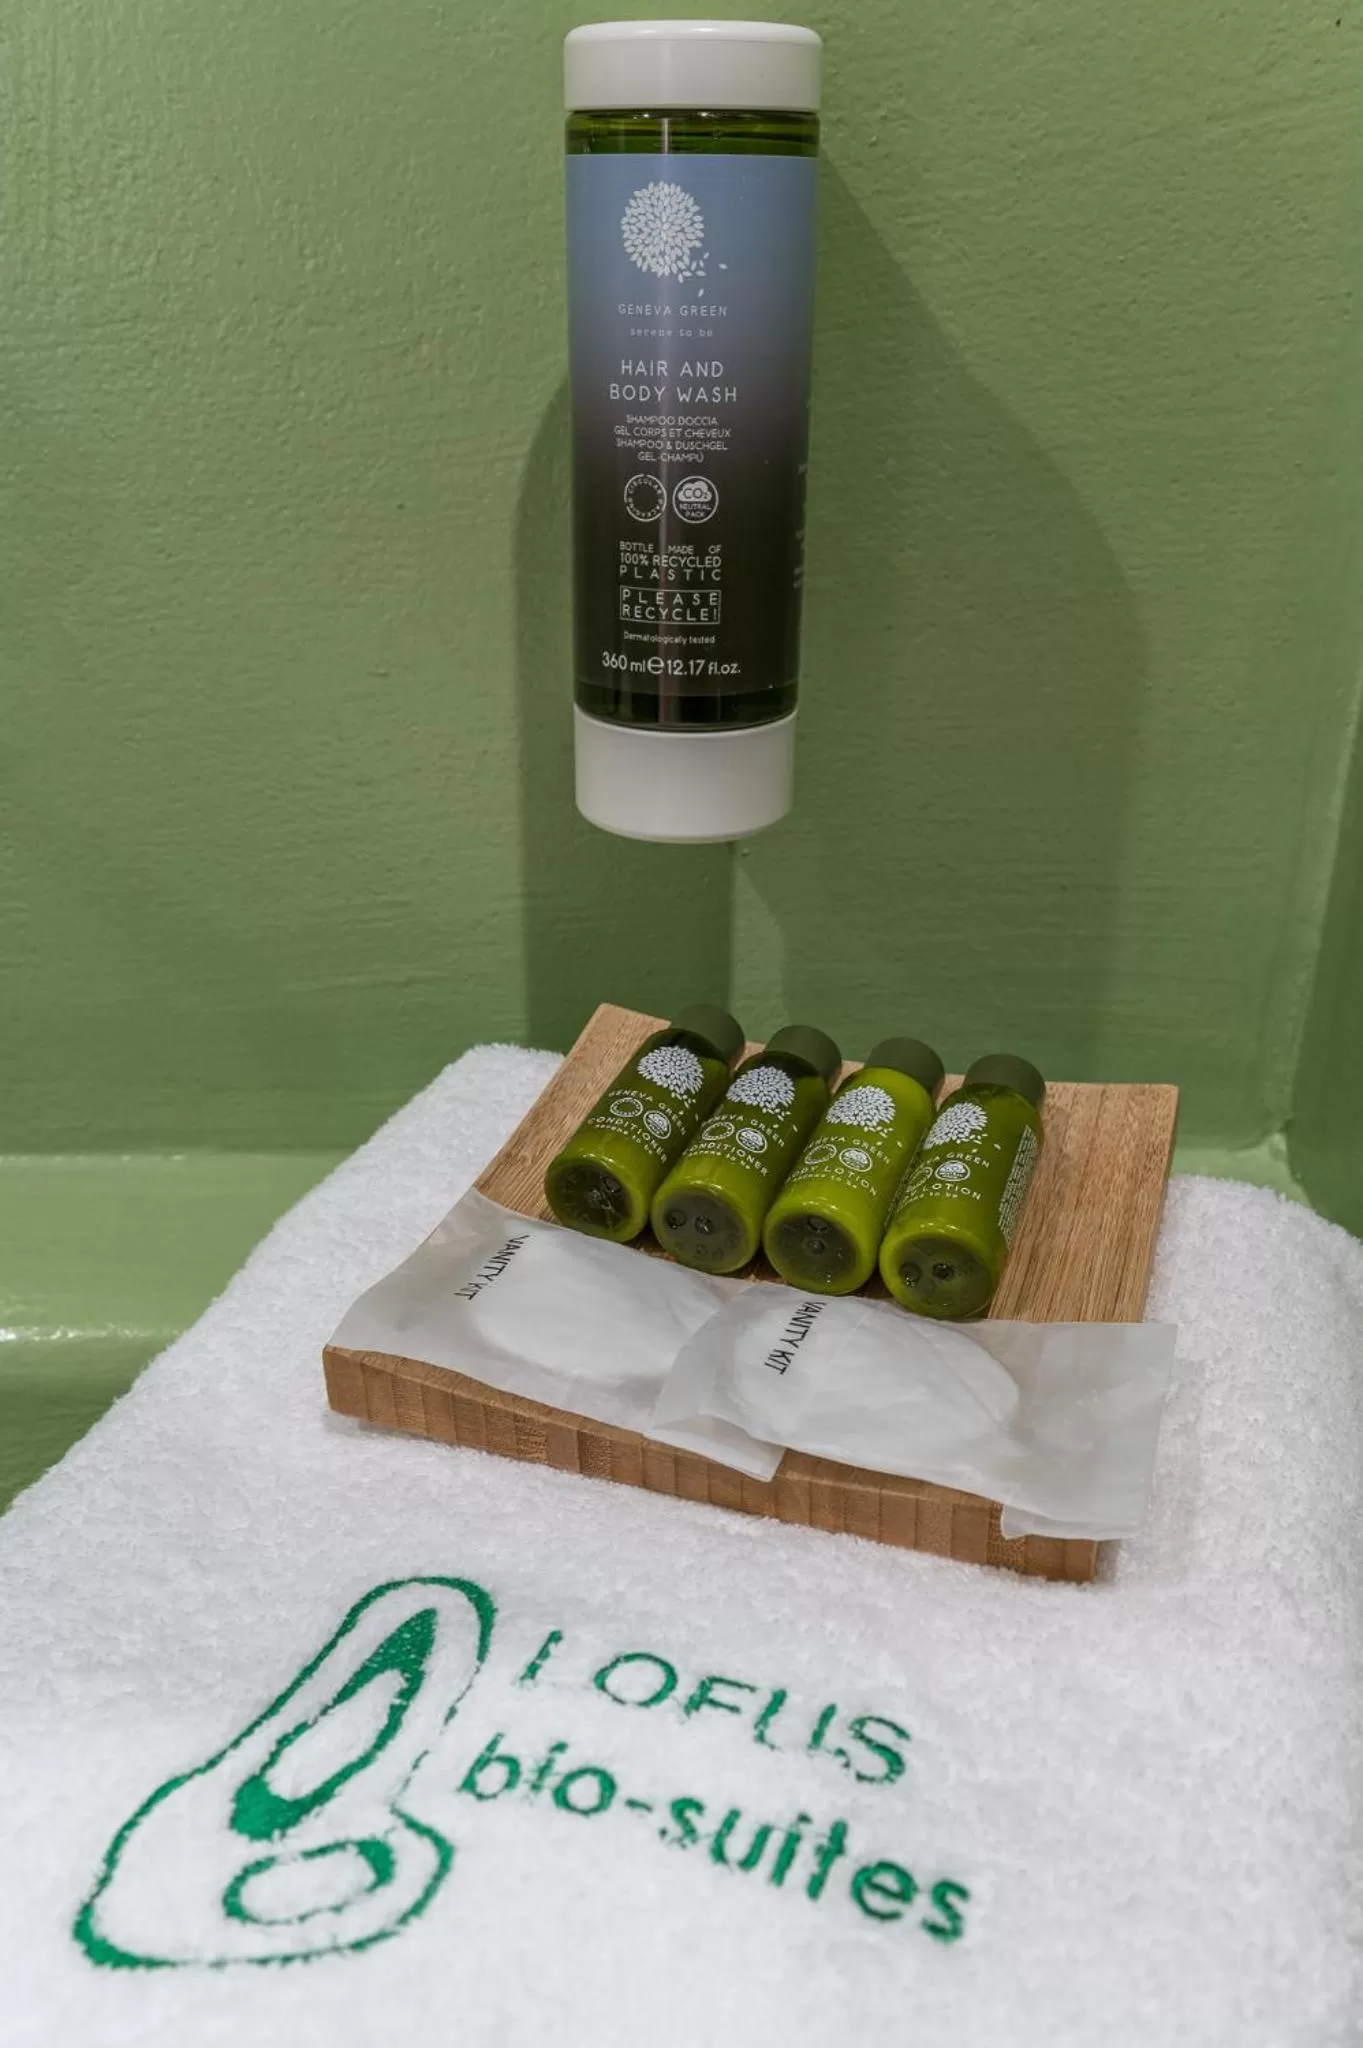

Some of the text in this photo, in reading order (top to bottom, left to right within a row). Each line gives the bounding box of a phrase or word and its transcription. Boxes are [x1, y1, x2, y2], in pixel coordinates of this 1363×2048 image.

[618, 303, 727, 318] GENEVA GREEN
[621, 360, 724, 378] HAIR AND
[609, 383, 737, 403] BODY WASH
[626, 414, 718, 427] SHAMPOO DOCCIA
[614, 425, 732, 439] GEL CORPS ET CHEVEUX
[616, 437, 728, 451] SHAMPOO & DUSCHGEL
[619, 541, 722, 554] BOTTLE MADE OF
[620, 552, 722, 568] 100% RECYCLED
[619, 565, 722, 581] PLASTIC
[622, 588, 719, 606] PLEASE
[622, 605, 718, 622] RECYCLE!
[623, 631, 716, 645] Dermatologically tested
[602, 651, 627, 670] 360
[630, 658, 646, 671] ml
[667, 660, 705, 675] 12.17
[708, 660, 741, 675] fl.oz.
[946, 1151, 990, 1168] GREEN
[824, 1165, 877, 1196] LOTION
[454, 1234, 530, 1301] VANITY KIT
[764, 1300, 826, 1376] VANITY KIT
[457, 1731, 973, 1944] bio-suites
